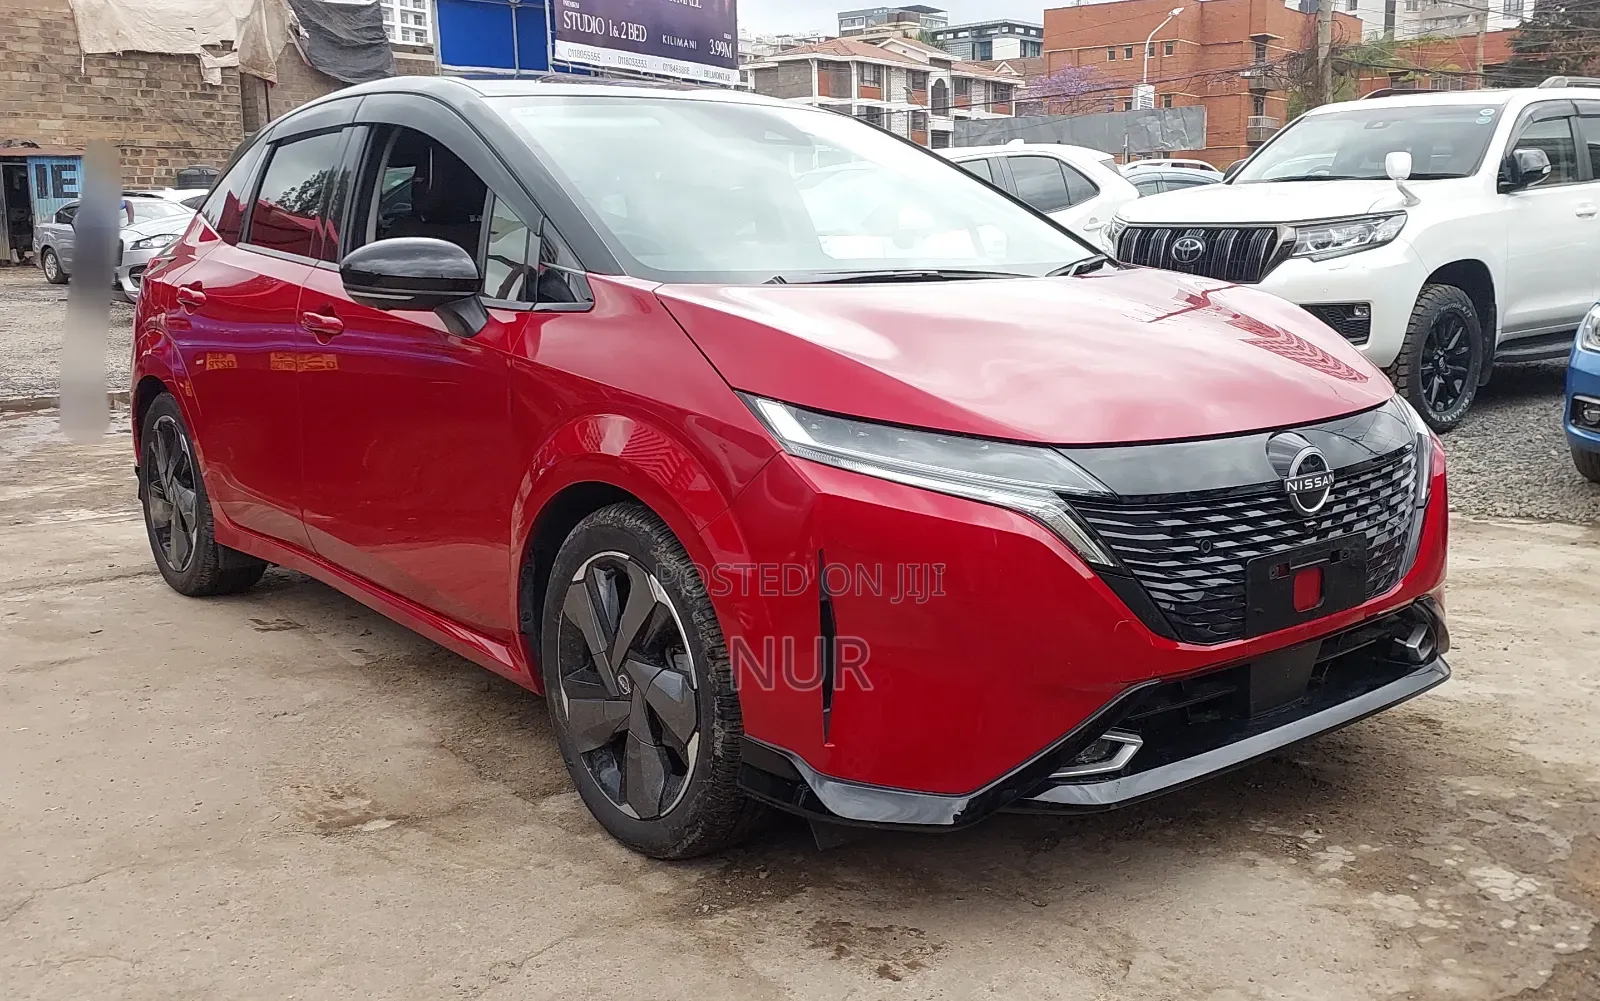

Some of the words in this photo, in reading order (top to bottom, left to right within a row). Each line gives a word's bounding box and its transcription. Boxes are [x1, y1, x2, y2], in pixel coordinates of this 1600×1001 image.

[563, 10, 605, 35] STUDIO
[628, 22, 648, 43] BED
[662, 33, 698, 50] KILIMANI
[709, 38, 733, 59] 3.99M
[1287, 473, 1334, 492] NISSAN
